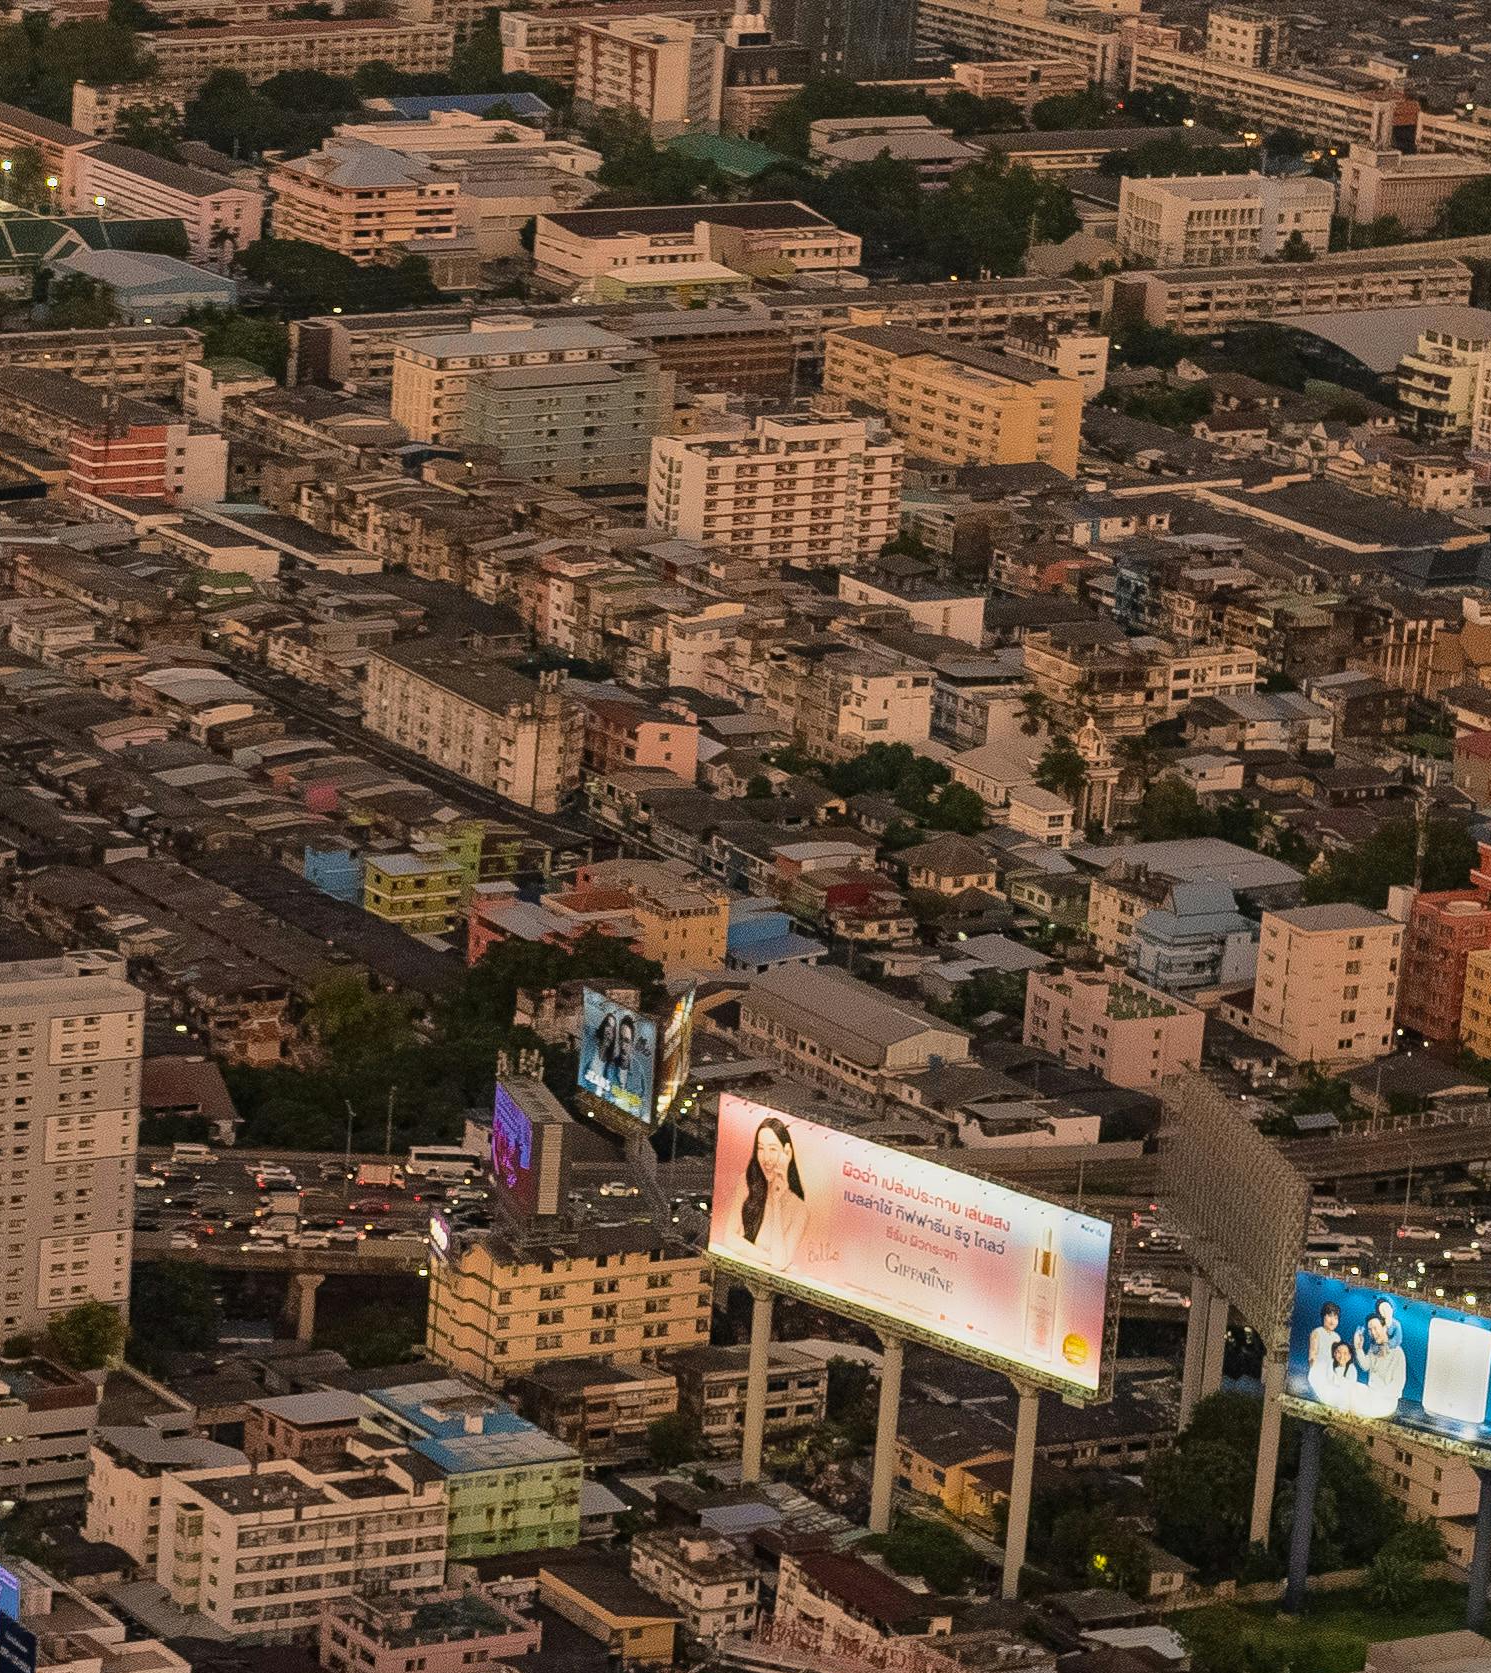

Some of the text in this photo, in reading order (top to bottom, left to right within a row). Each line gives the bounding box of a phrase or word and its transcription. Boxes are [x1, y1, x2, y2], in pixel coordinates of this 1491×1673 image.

[844, 1190, 893, 1216] เบลล่าใช้
[895, 1205, 951, 1237] กิฟฟารีน
[954, 1226, 971, 1248] รีจู
